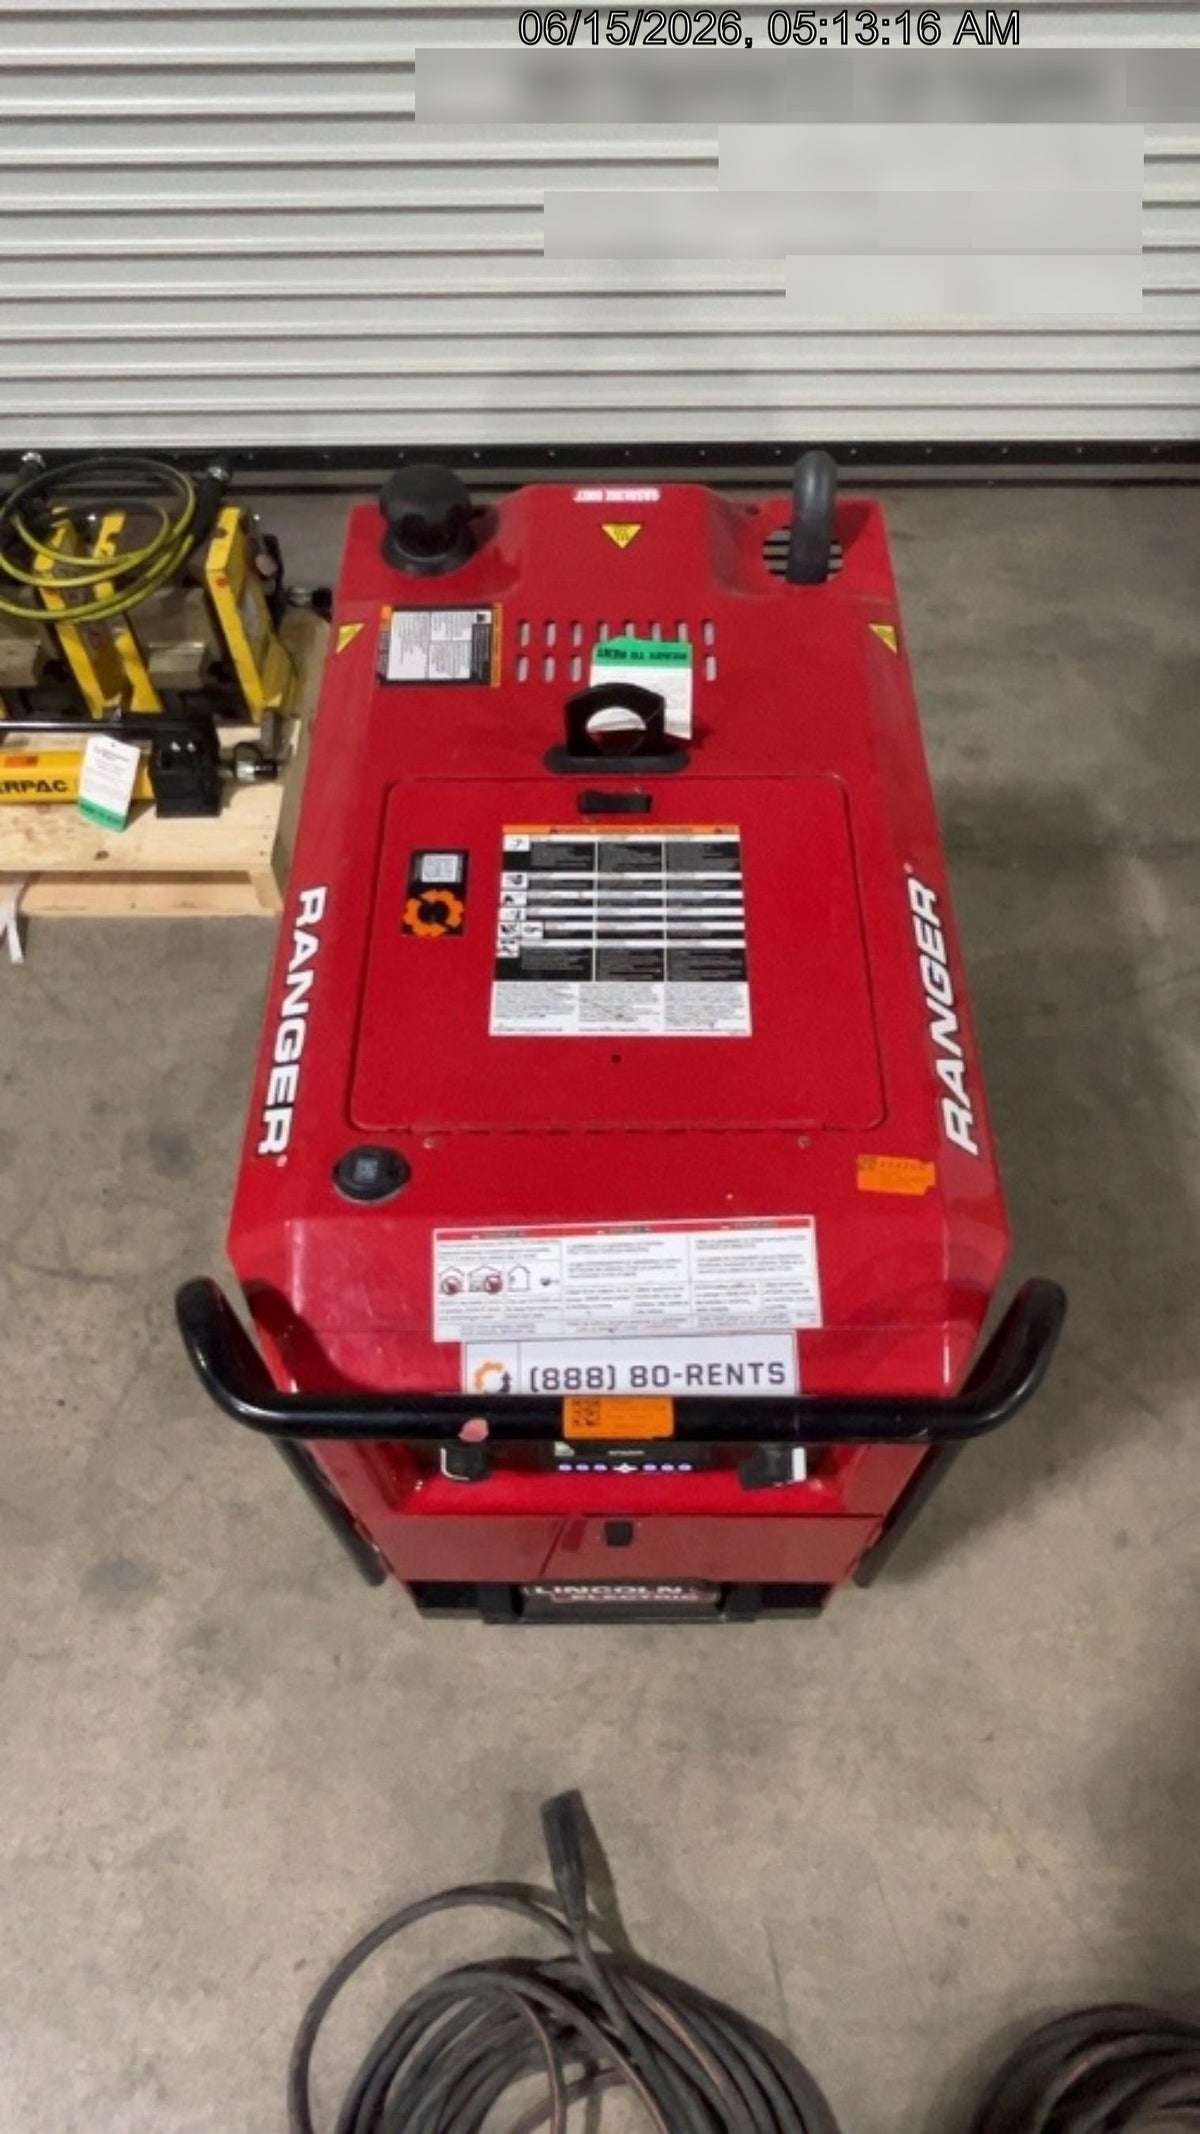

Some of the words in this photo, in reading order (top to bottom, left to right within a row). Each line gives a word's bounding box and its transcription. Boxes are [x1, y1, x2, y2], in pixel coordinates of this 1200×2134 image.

[630, 651, 643, 660] TO
[649, 651, 687, 660] READY
[258, 886, 328, 1155] RANGER
[907, 877, 979, 1156] RANGER
[530, 1364, 617, 1393] (888)
[629, 1361, 787, 1389] 80-RENTS
[534, 1584, 683, 1595] LINCOLN
